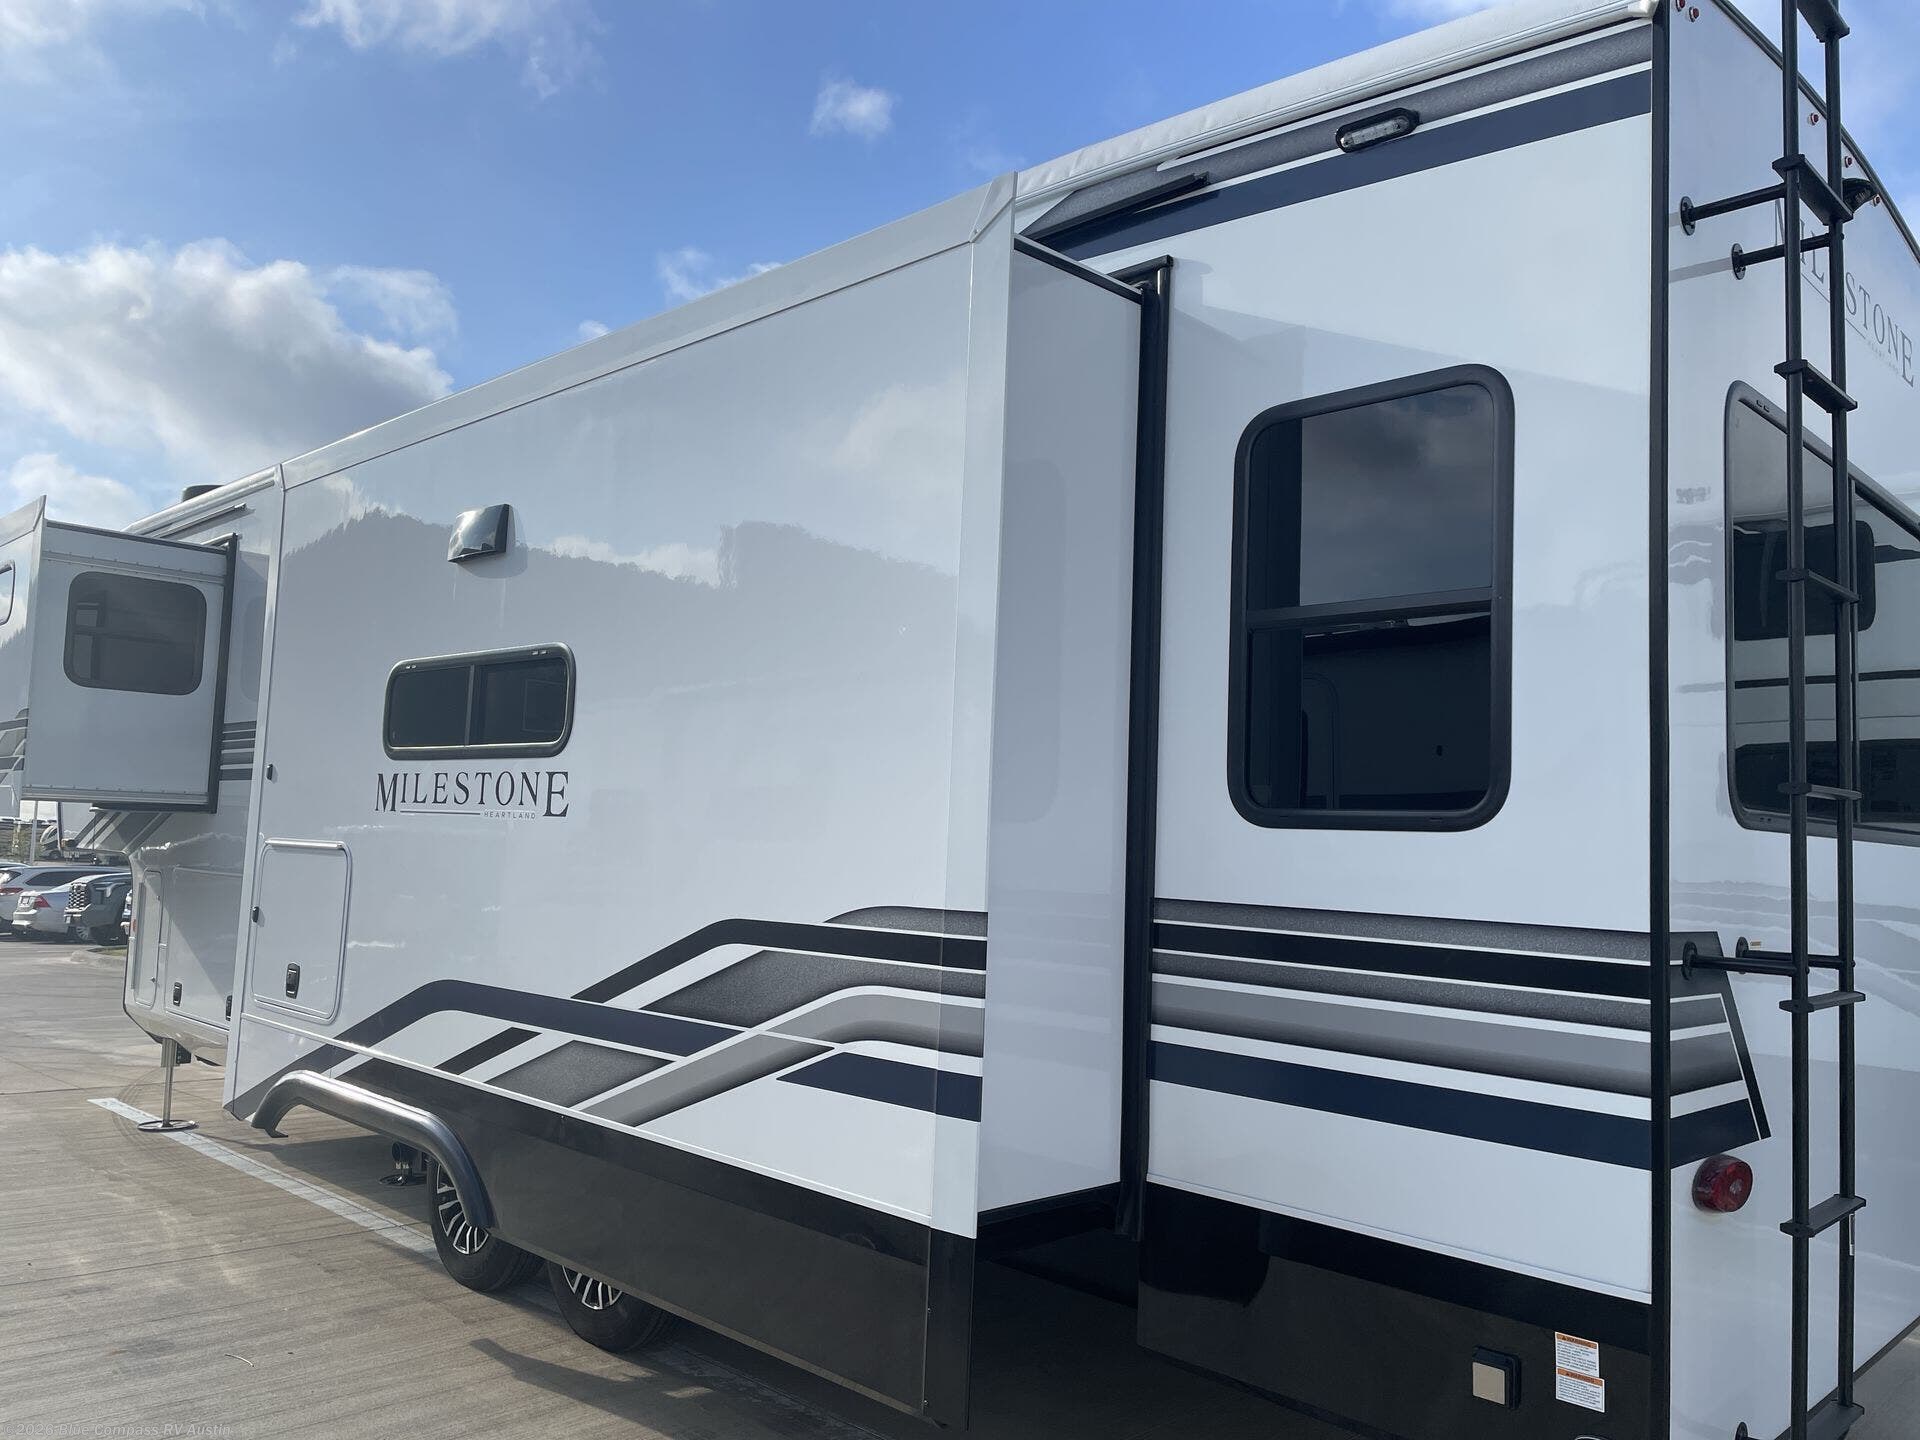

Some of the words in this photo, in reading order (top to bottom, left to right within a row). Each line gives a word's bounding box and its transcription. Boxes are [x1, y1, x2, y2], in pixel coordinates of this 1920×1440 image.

[1775, 198, 1914, 387] ILSTONE
[375, 771, 569, 817] MILESTONE
[484, 811, 536, 819] HEARTLAND
